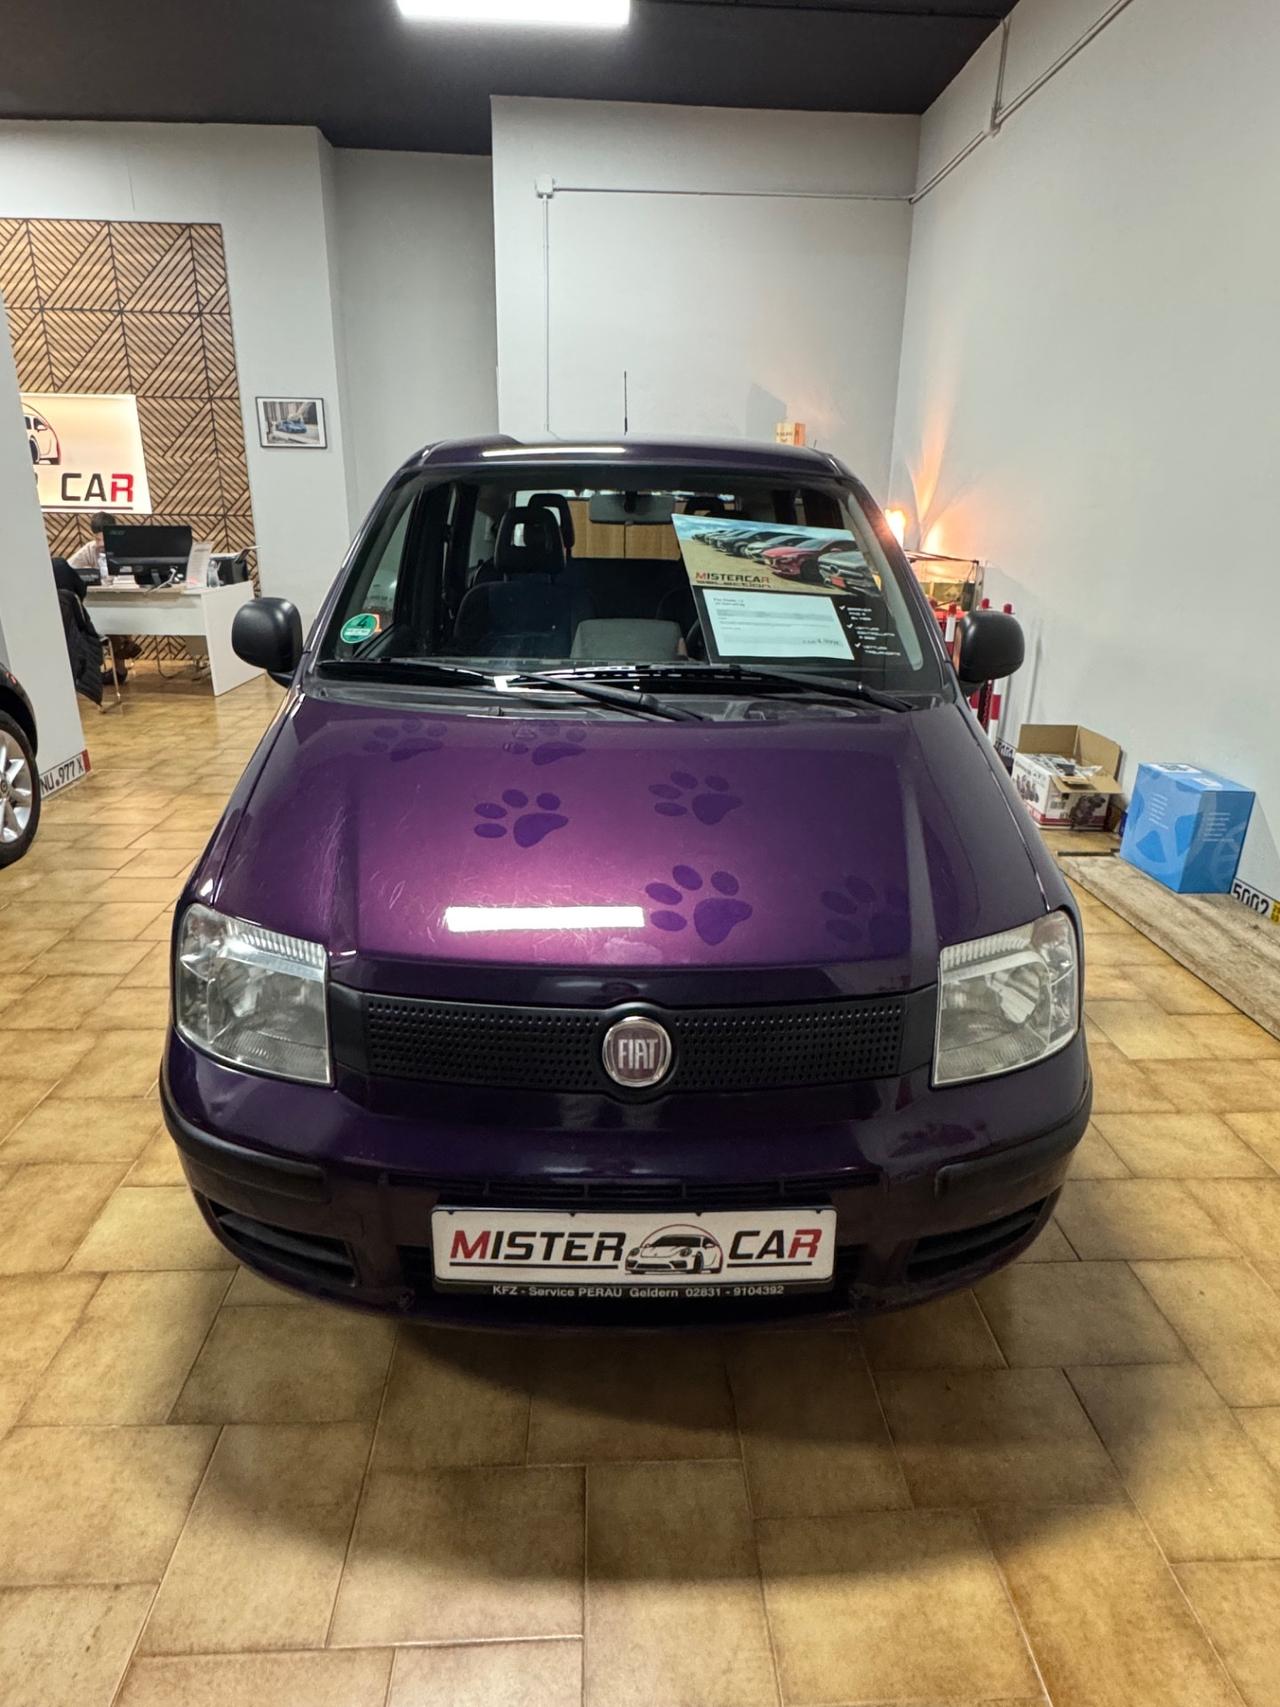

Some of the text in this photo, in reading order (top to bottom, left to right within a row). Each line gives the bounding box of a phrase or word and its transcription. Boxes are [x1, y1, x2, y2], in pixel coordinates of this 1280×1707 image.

[61, 473, 134, 502] CAR
[696, 572, 770, 583] MISTERCAR
[356, 615, 369, 628] 4
[617, 1038, 658, 1070] FIAT
[450, 1229, 822, 1262] MISTER CAR
[492, 1286, 518, 1296] KFZ
[529, 1286, 575, 1297] Service
[578, 1288, 622, 1298] PERAU
[629, 1287, 679, 1298] Geldern
